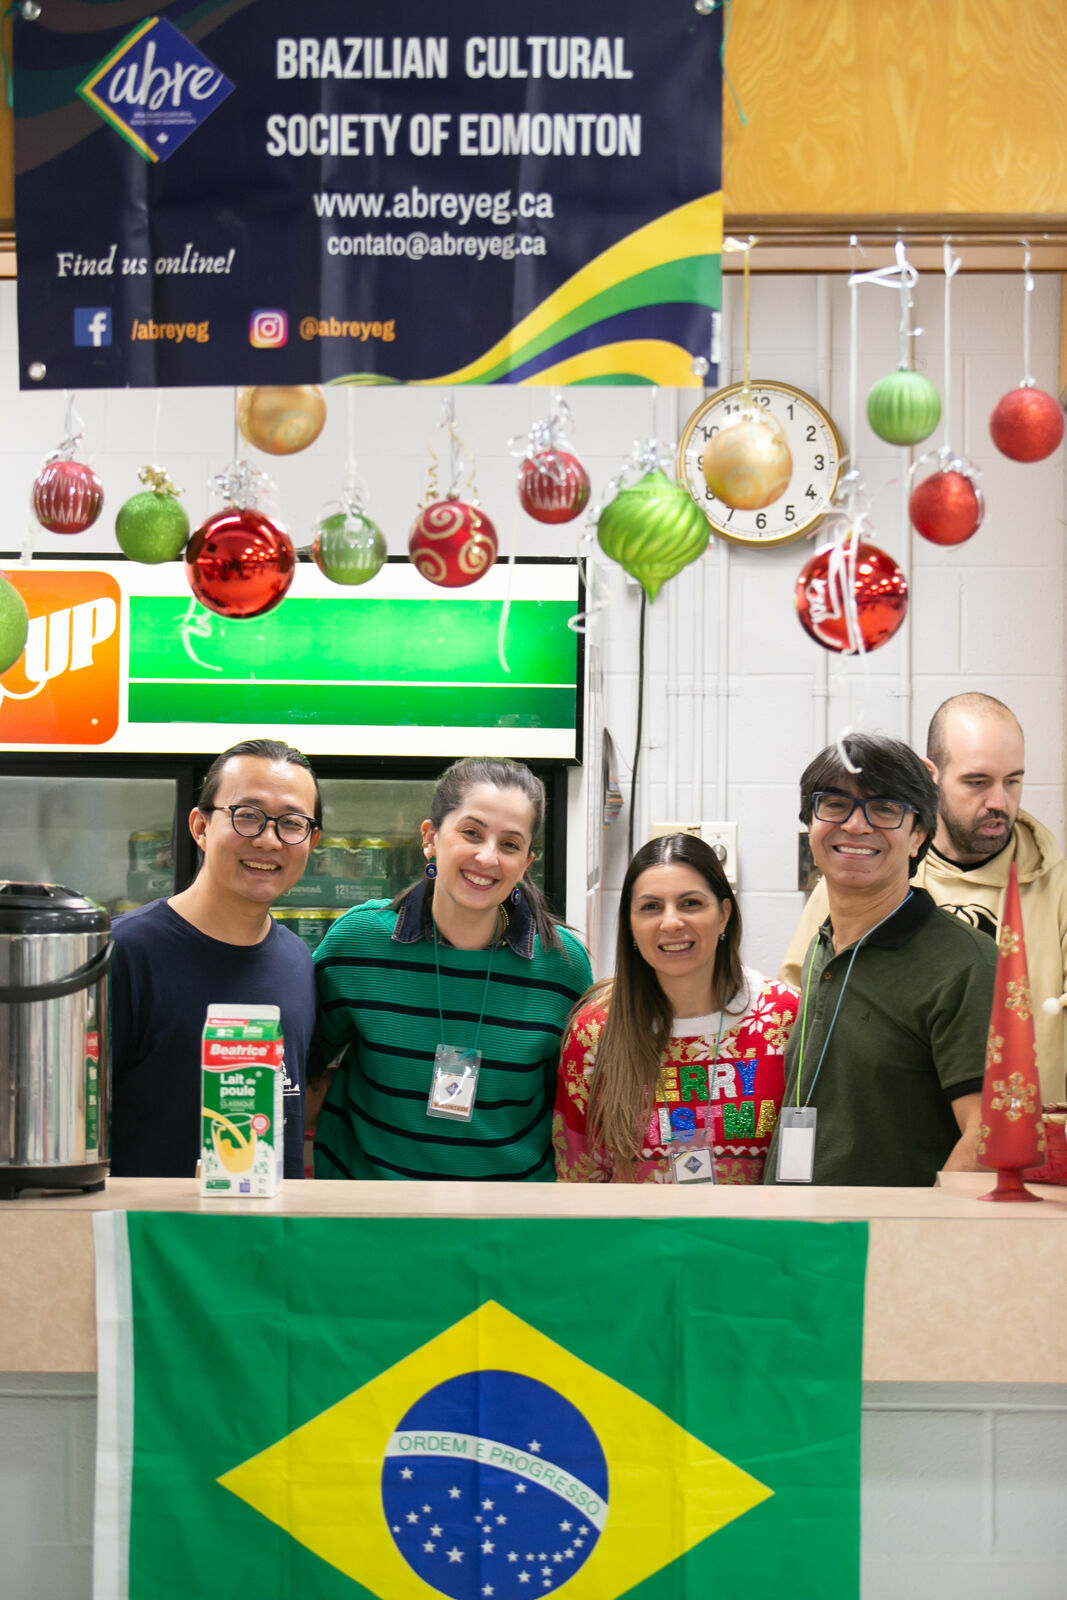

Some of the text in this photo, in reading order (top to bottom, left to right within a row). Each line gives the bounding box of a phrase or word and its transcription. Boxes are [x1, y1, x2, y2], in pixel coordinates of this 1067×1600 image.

[276, 36, 634, 80] BRAZILIAN CULTURAL
[108, 40, 225, 111] abre
[266, 112, 642, 157] SOCIETY OF EDMONTON
[313, 186, 554, 225] www.abreyeg.ca
[326, 231, 547, 261] contato@abreyeg.ca
[56, 243, 236, 278] Find us online!
[130, 318, 210, 343] /abreyeg
[299, 316, 396, 342] @abreyeg
[786, 404, 794, 421] 1
[805, 425, 817, 442] 2
[813, 454, 825, 471] 3
[804, 483, 817, 500] 4
[755, 512, 767, 530] 6
[784, 505, 796, 522] 5
[10, 597, 117, 699] UP
[210, 1043, 268, 1057] Beatrice
[220, 1073, 245, 1085] Lait
[220, 1085, 256, 1098] poule
[655, 1059, 759, 1103] ERRY
[647, 1099, 778, 1146] ISTMA
[399, 1435, 601, 1516] ORDEM E PROGRESSO
